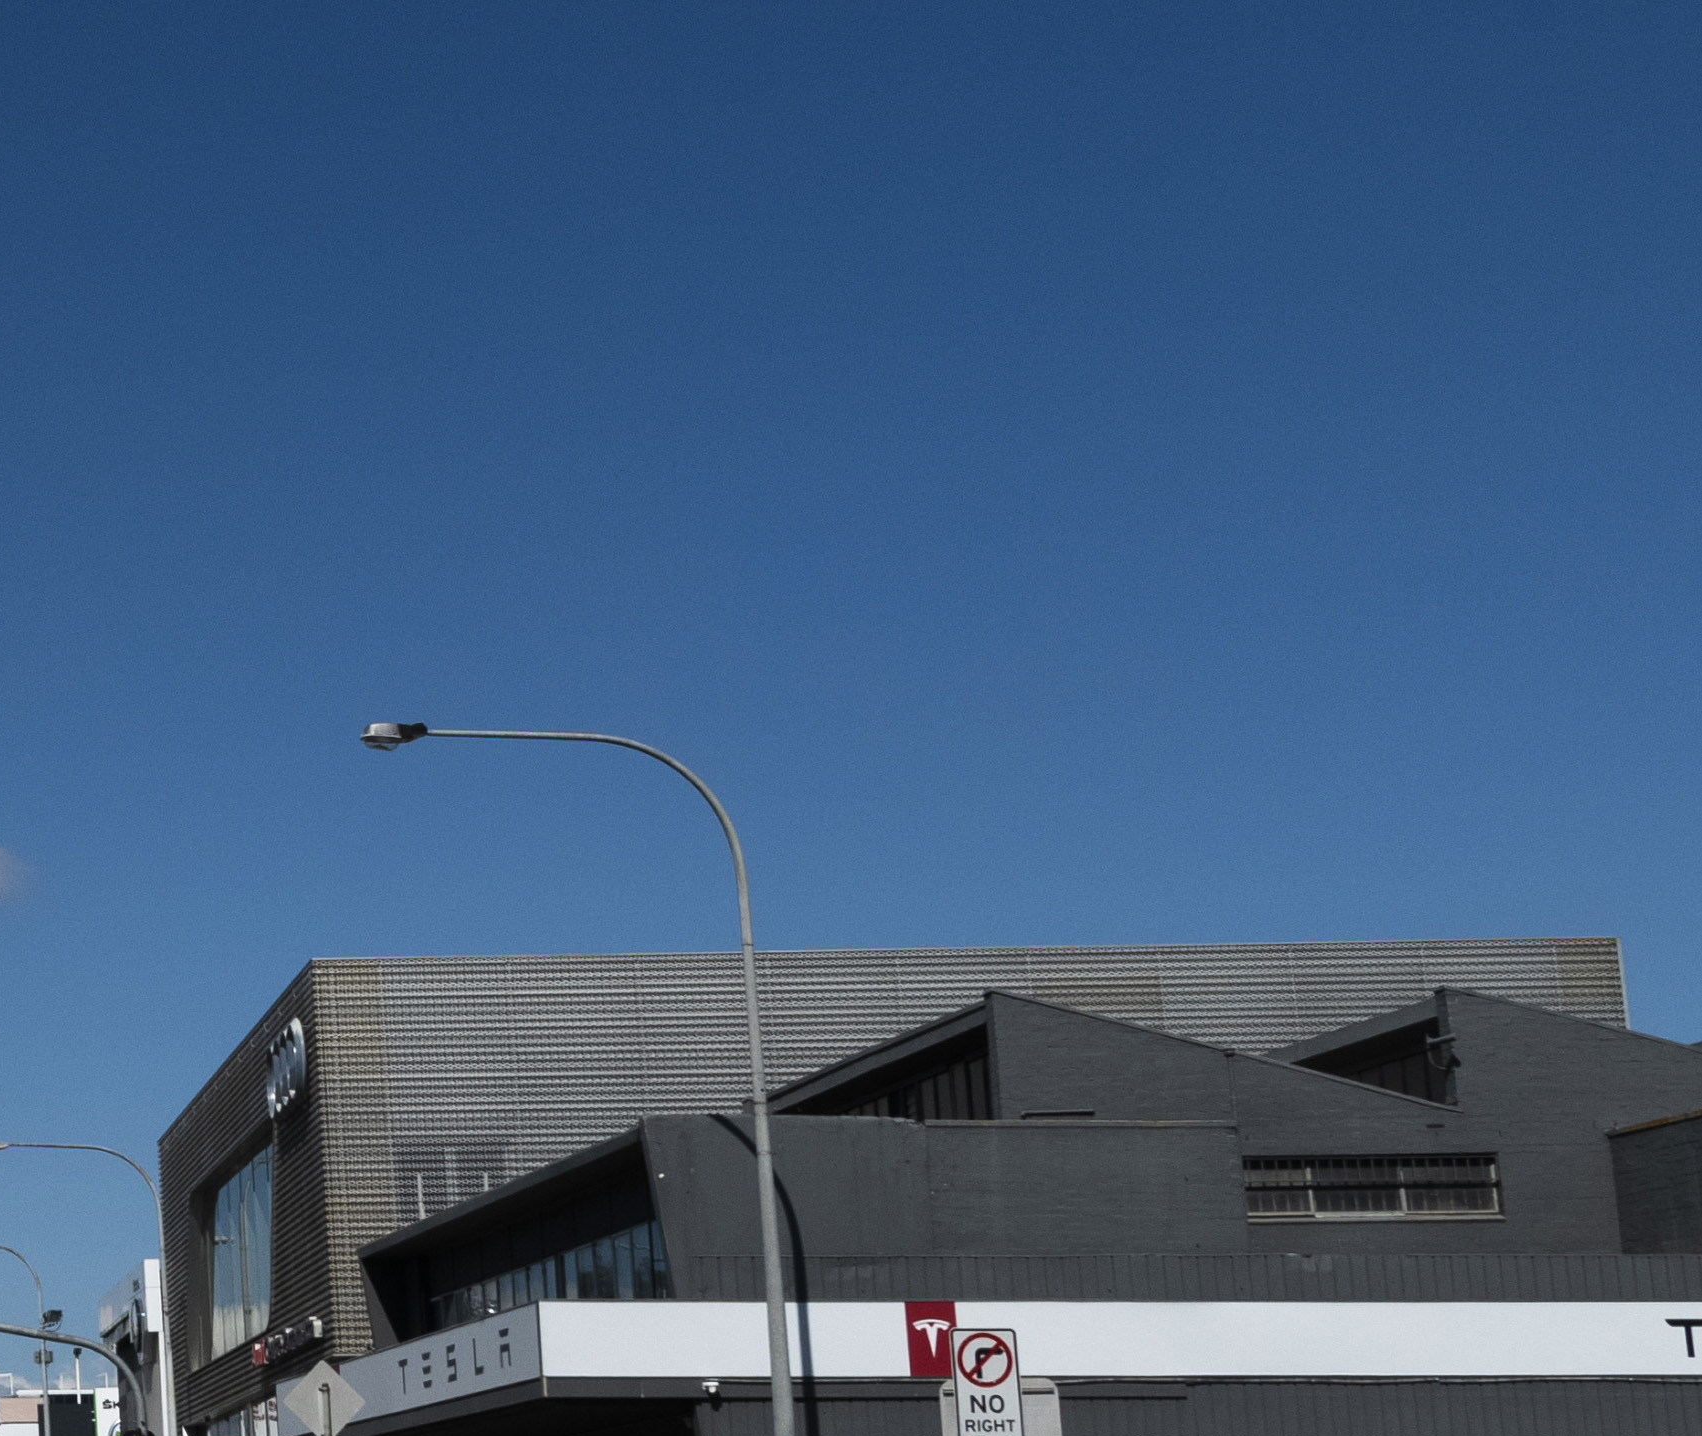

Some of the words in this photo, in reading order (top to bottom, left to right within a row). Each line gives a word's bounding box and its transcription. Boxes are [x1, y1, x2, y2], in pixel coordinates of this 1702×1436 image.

[398, 1328, 511, 1395] TESLA
[969, 1395, 1005, 1415] NO
[965, 1419, 1015, 1432] RIGHT
